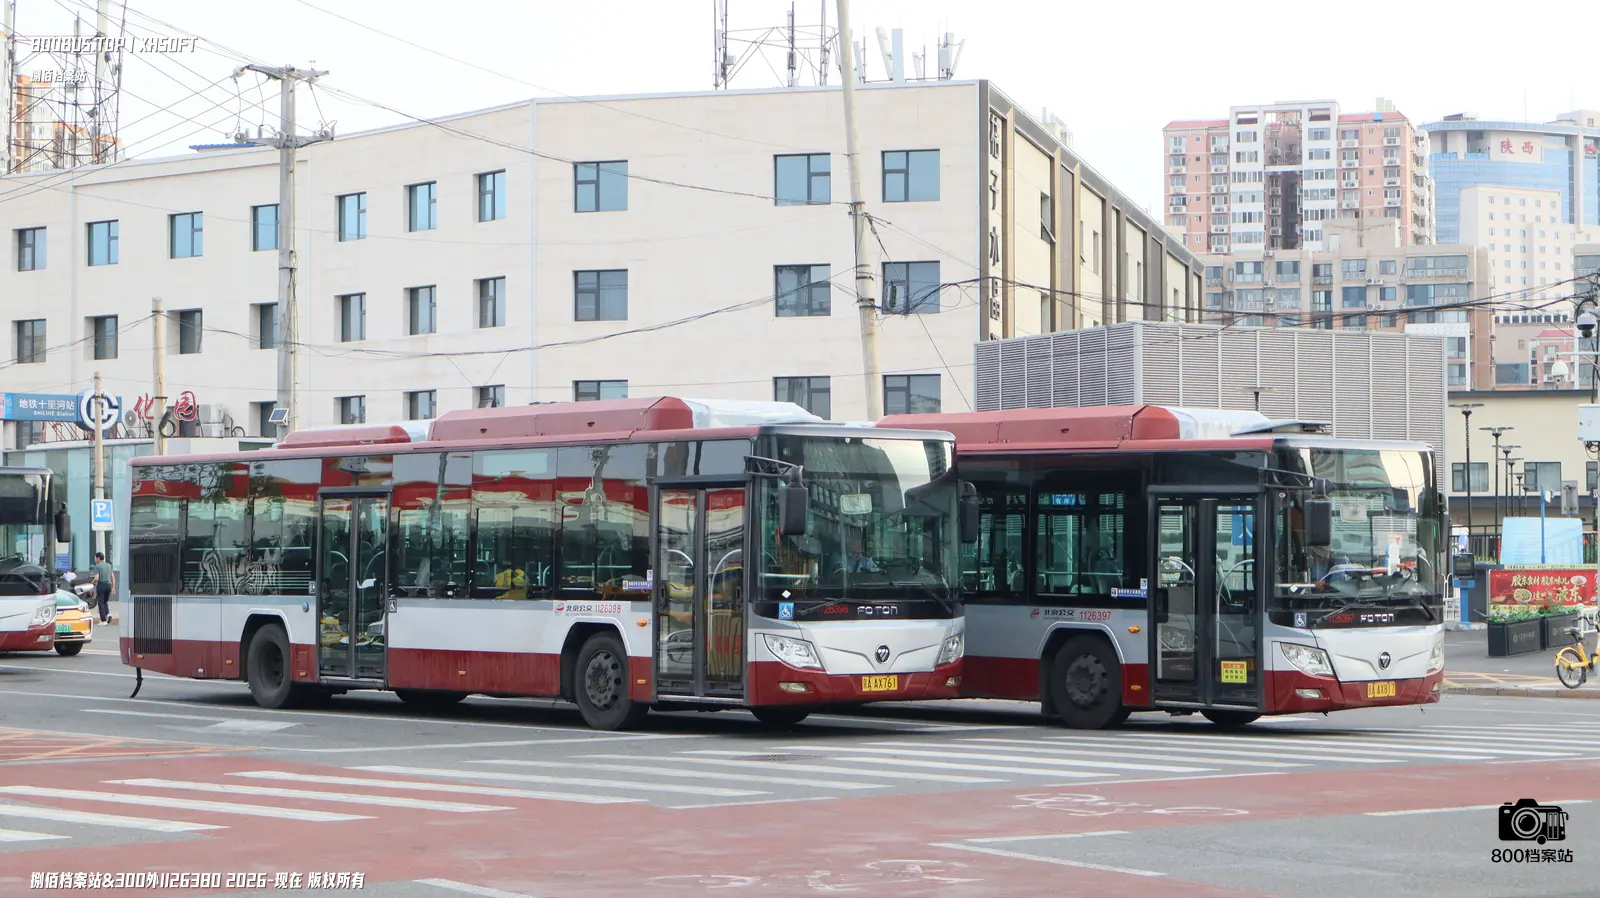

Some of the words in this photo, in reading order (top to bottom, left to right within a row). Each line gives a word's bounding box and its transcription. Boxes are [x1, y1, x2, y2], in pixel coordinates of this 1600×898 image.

[1500, 138, 1535, 156] 陕西
[19, 398, 75, 411] 地铁十里河站
[95, 502, 107, 518] P
[566, 604, 593, 612] 北京公交
[595, 604, 622, 614] 1126398
[857, 605, 899, 616] FOTON
[1044, 608, 1075, 617] 北京公交
[1079, 611, 1112, 621] 1126397
[1360, 613, 1395, 623] FOTON
